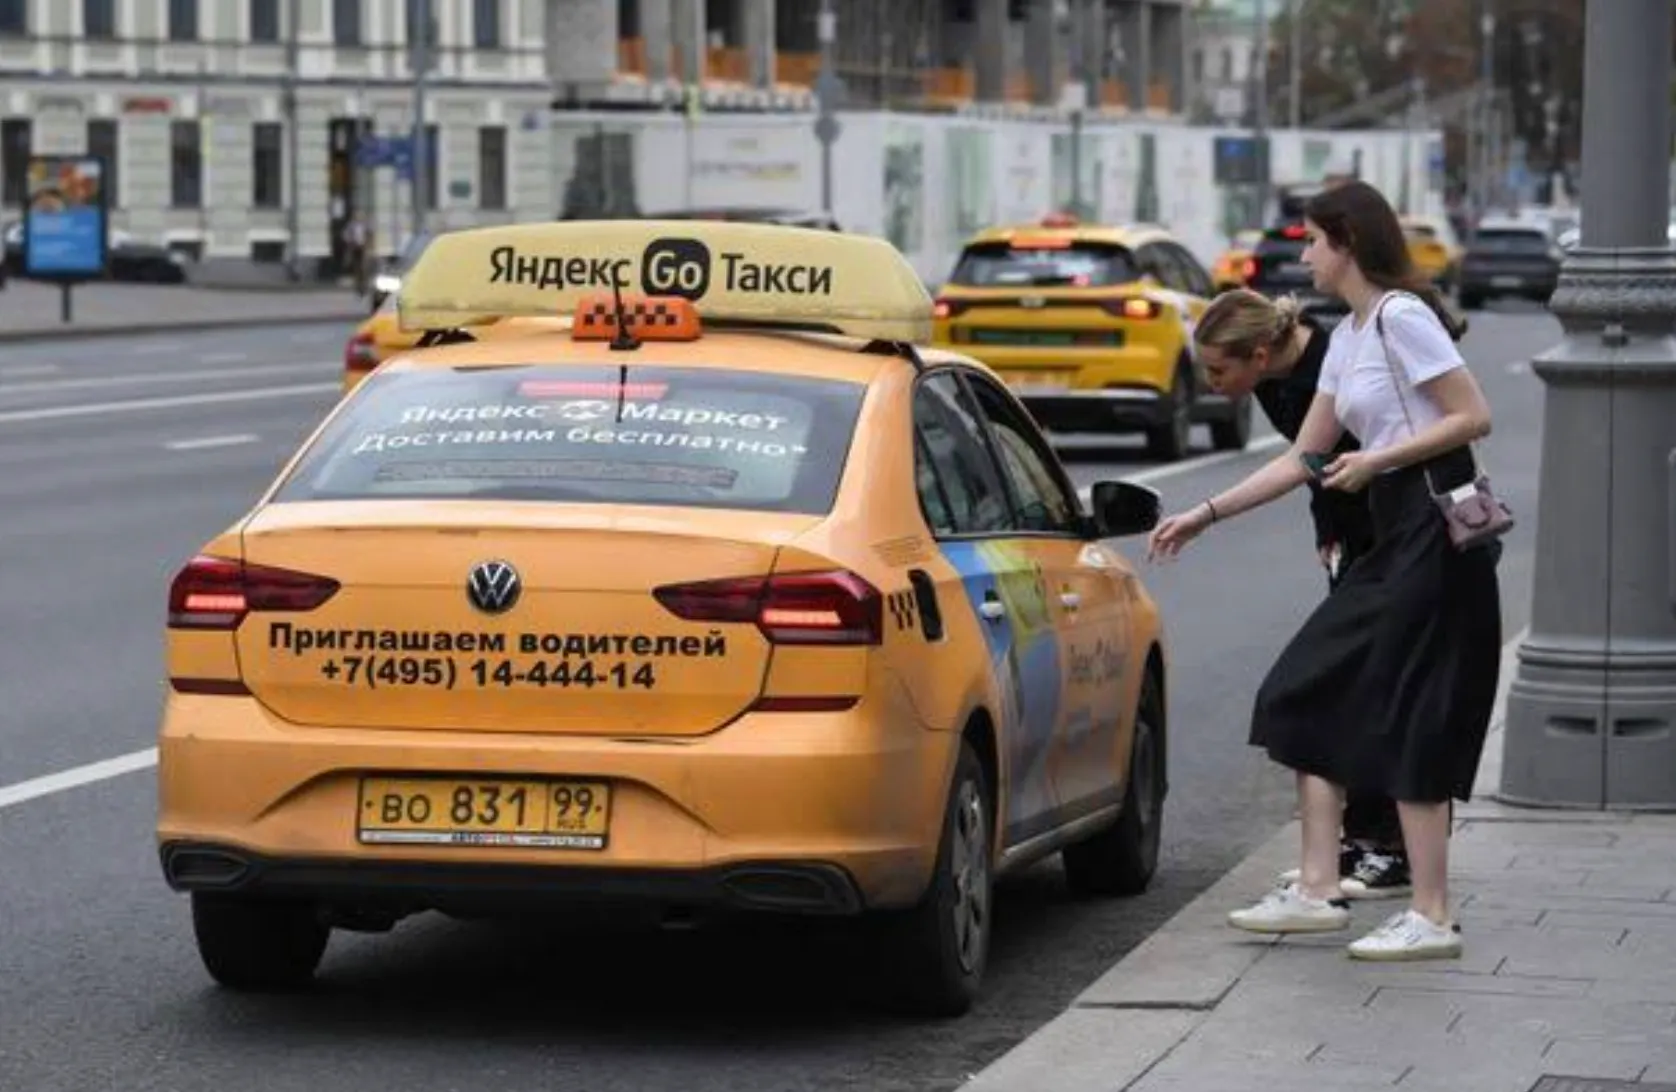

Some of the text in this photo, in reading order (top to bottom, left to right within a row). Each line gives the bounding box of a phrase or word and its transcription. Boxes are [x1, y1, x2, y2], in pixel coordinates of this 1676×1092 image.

[490, 246, 832, 295] Яндекс Go Такси
[401, 402, 789, 431] Яндекс Маркет
[352, 428, 556, 455] Доставим
[269, 621, 727, 658] Приглашаем водителей
[321, 655, 655, 690] +7(495) 14-444-14
[450, 785, 527, 826] 831
[553, 787, 594, 818] 99
